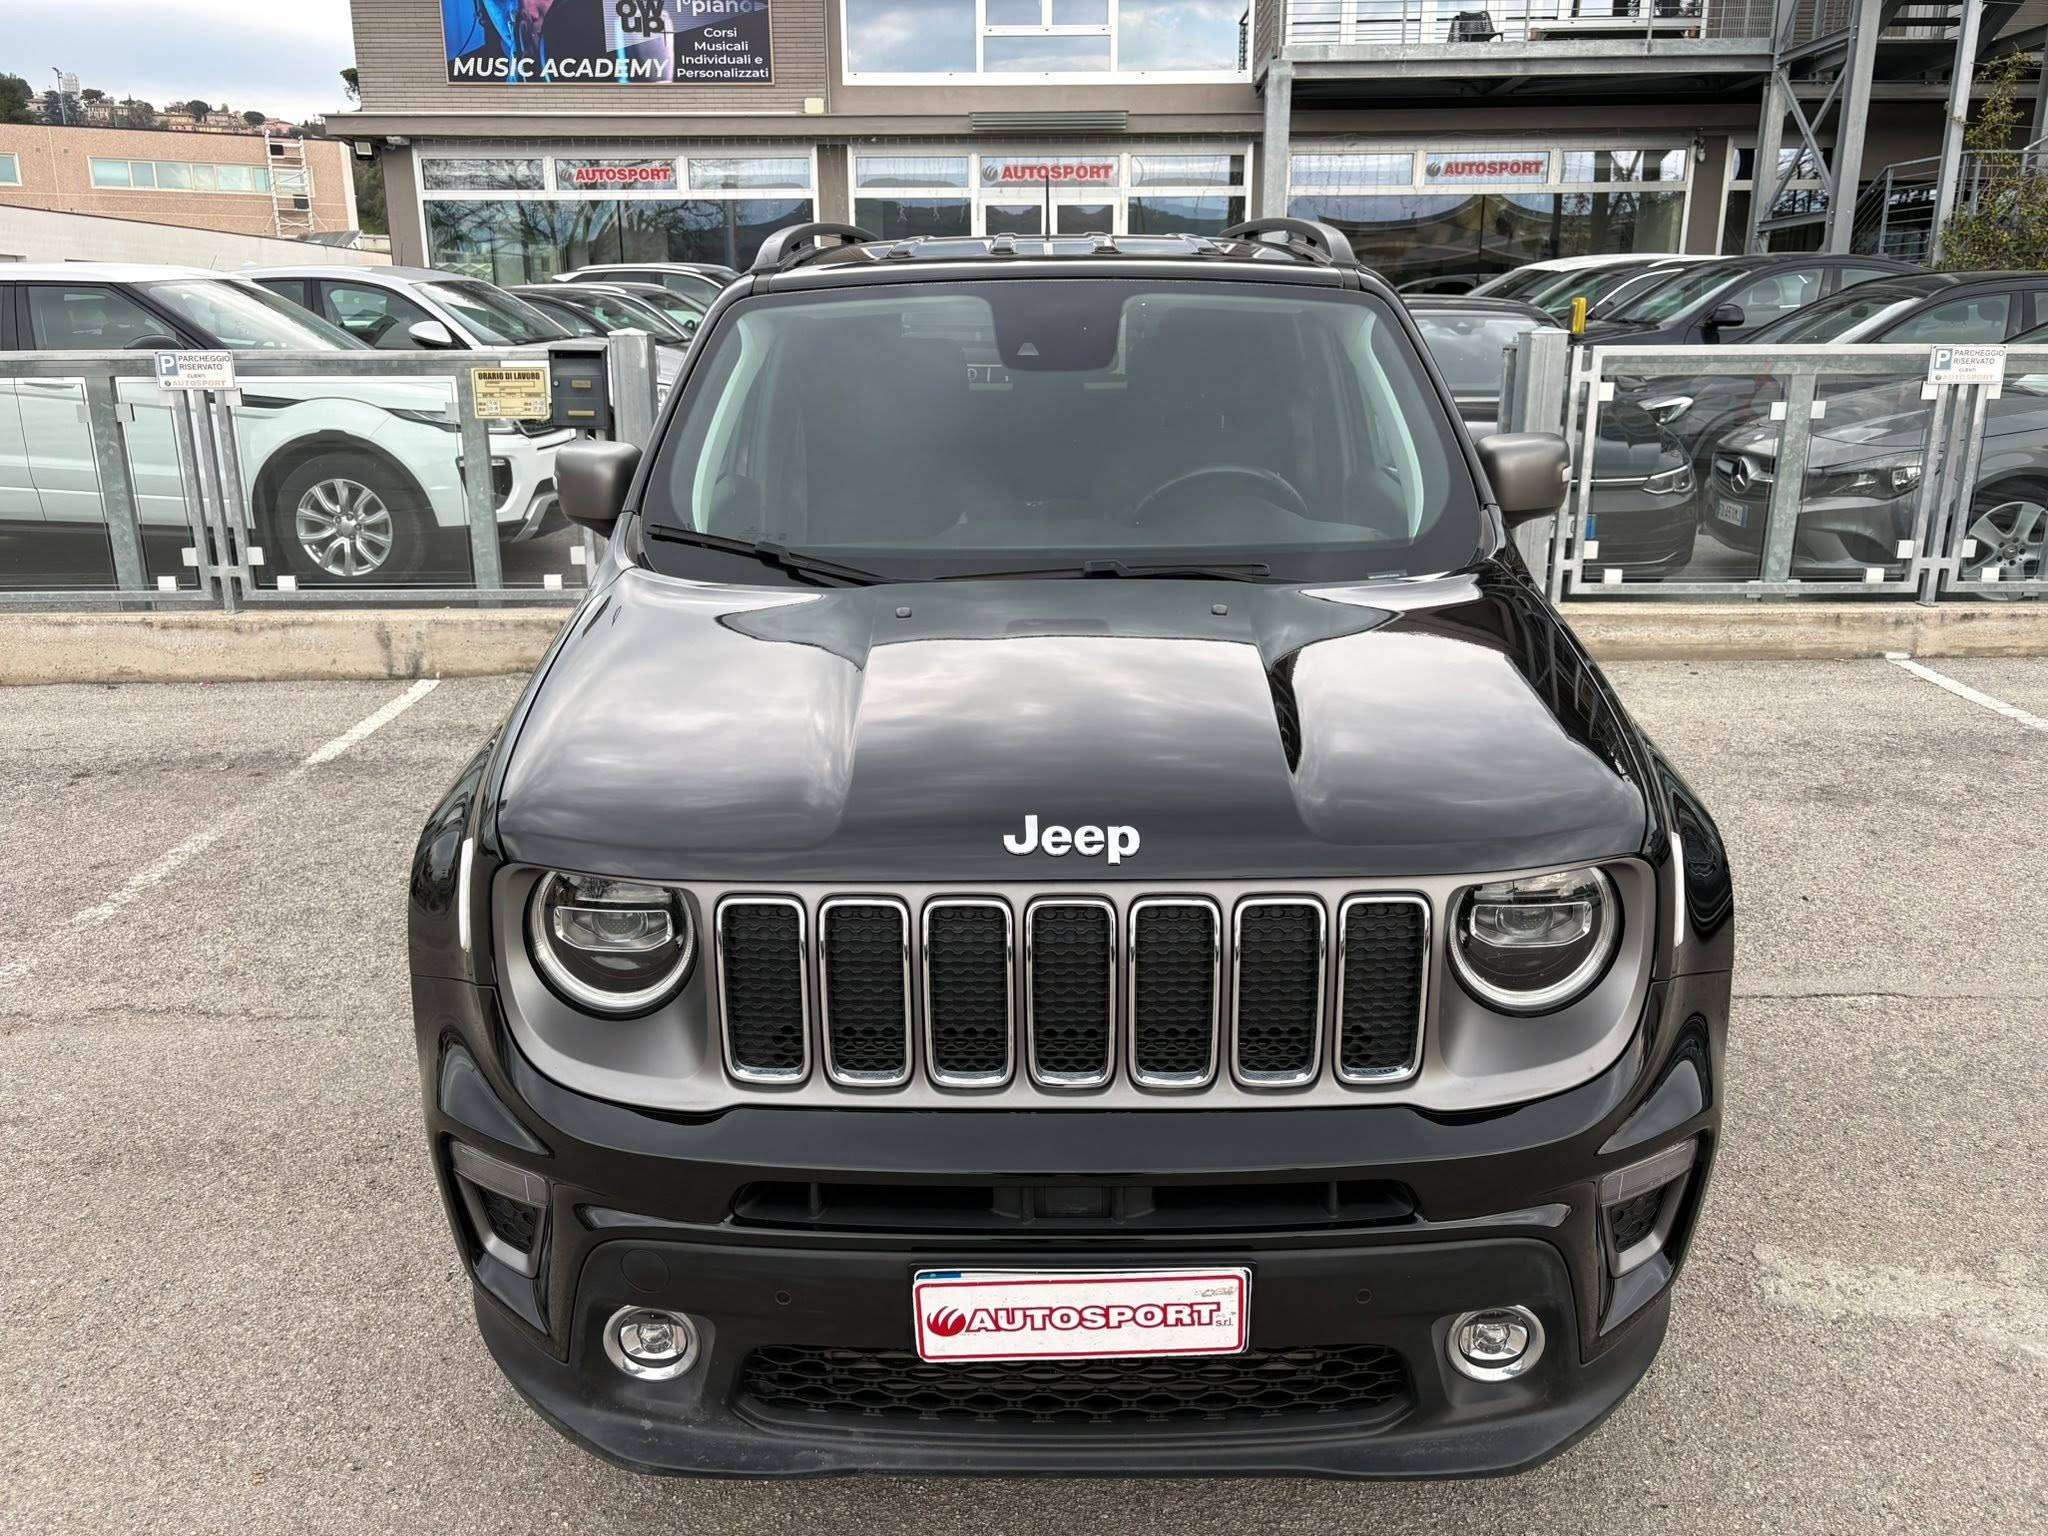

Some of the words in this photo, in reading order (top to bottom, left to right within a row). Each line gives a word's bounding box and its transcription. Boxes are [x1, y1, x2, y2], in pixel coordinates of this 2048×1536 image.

[703, 27, 738, 38] Corsi
[694, 40, 749, 51] Musicali
[681, 54, 751, 65] Individuali
[754, 57, 763, 65] e
[453, 57, 535, 77] MUSIC
[539, 58, 669, 78] ACADEMY
[677, 68, 769, 78] Personalizzati
[1001, 163, 1114, 181] AUTOSPORT
[1443, 160, 1544, 177] AUTOSPORT
[575, 167, 672, 182] AUTOSPORT
[1954, 349, 2005, 357] PARCHEGGIO
[179, 363, 223, 371] RISERVATO
[478, 372, 504, 380] ORARIO
[505, 372, 512, 380] DI
[514, 372, 540, 380] LAVORO
[1003, 814, 1141, 866] Jeep
[965, 1302, 1221, 1332] AUTOSPORT
